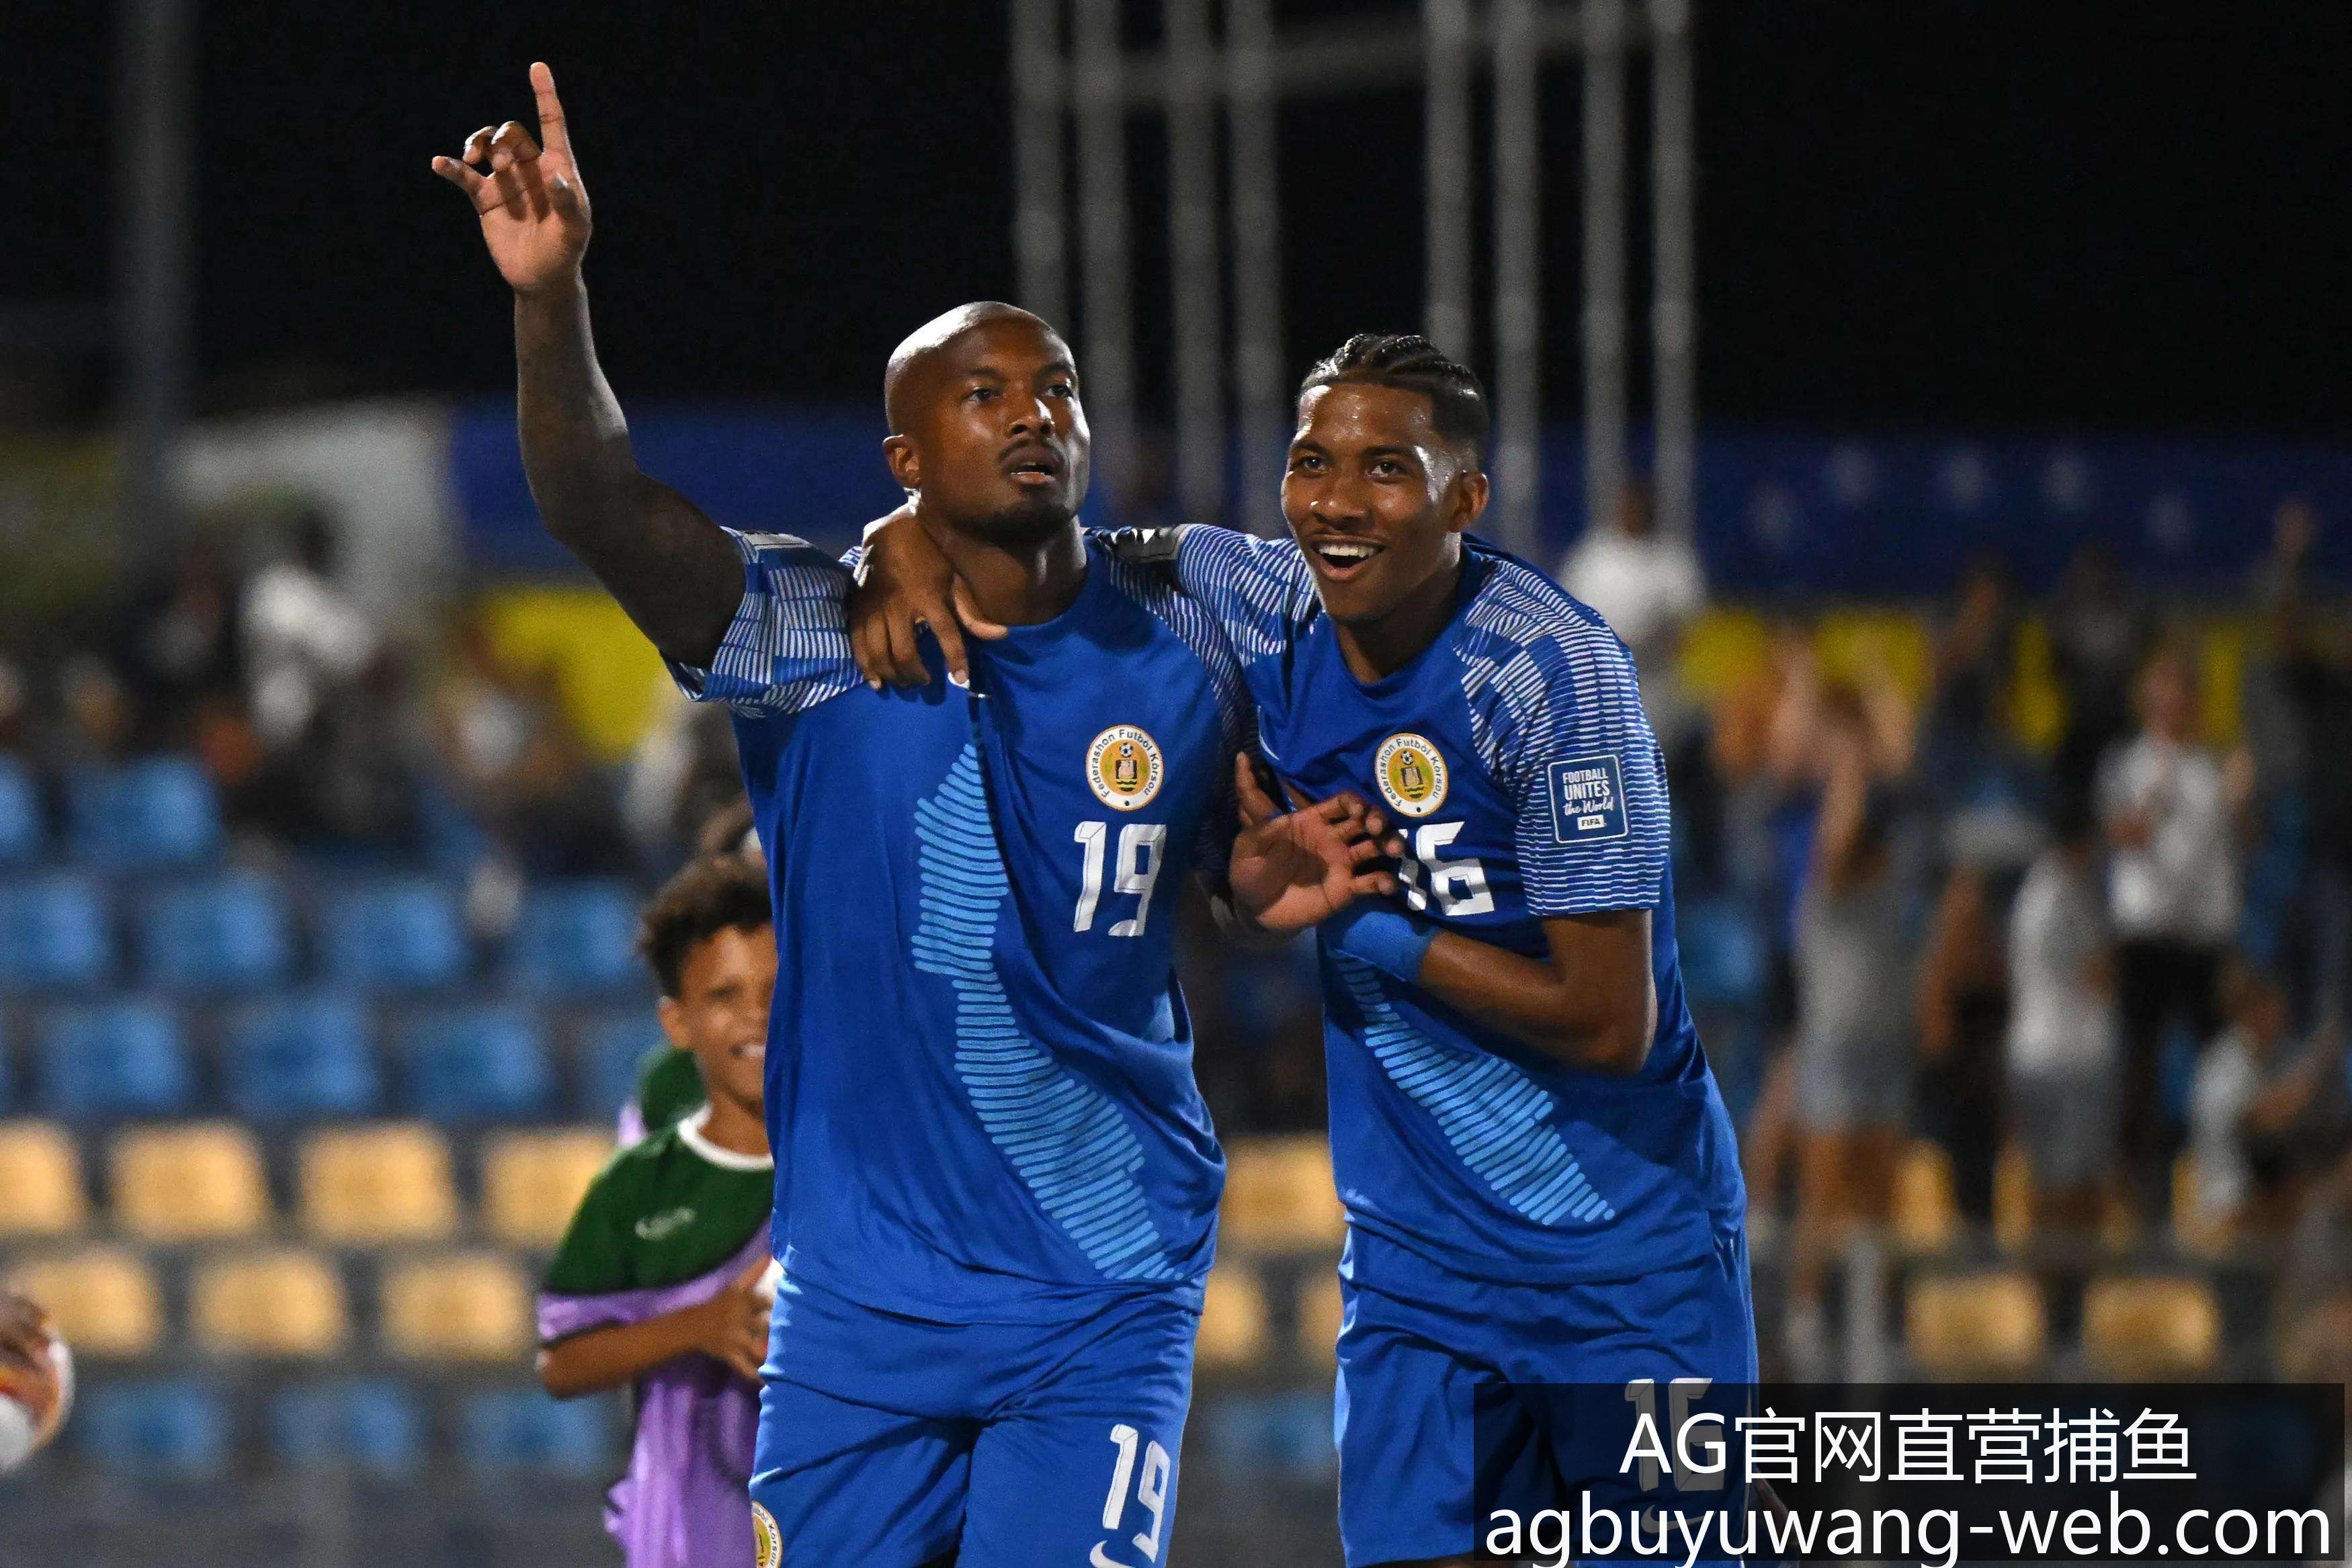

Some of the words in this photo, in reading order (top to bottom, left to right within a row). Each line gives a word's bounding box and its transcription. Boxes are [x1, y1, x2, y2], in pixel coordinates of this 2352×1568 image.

[1091, 734, 1116, 798] Federashon
[1379, 744, 1402, 808] Federashon
[1562, 767, 1609, 785] FOOTBALL
[1562, 800, 1582, 816] the
[1582, 796, 1614, 814] World
[1564, 780, 1611, 801] UNITES
[1581, 818, 1601, 827] FIFA
[1074, 821, 1167, 937] 19
[1101, 1424, 1171, 1564] 19
